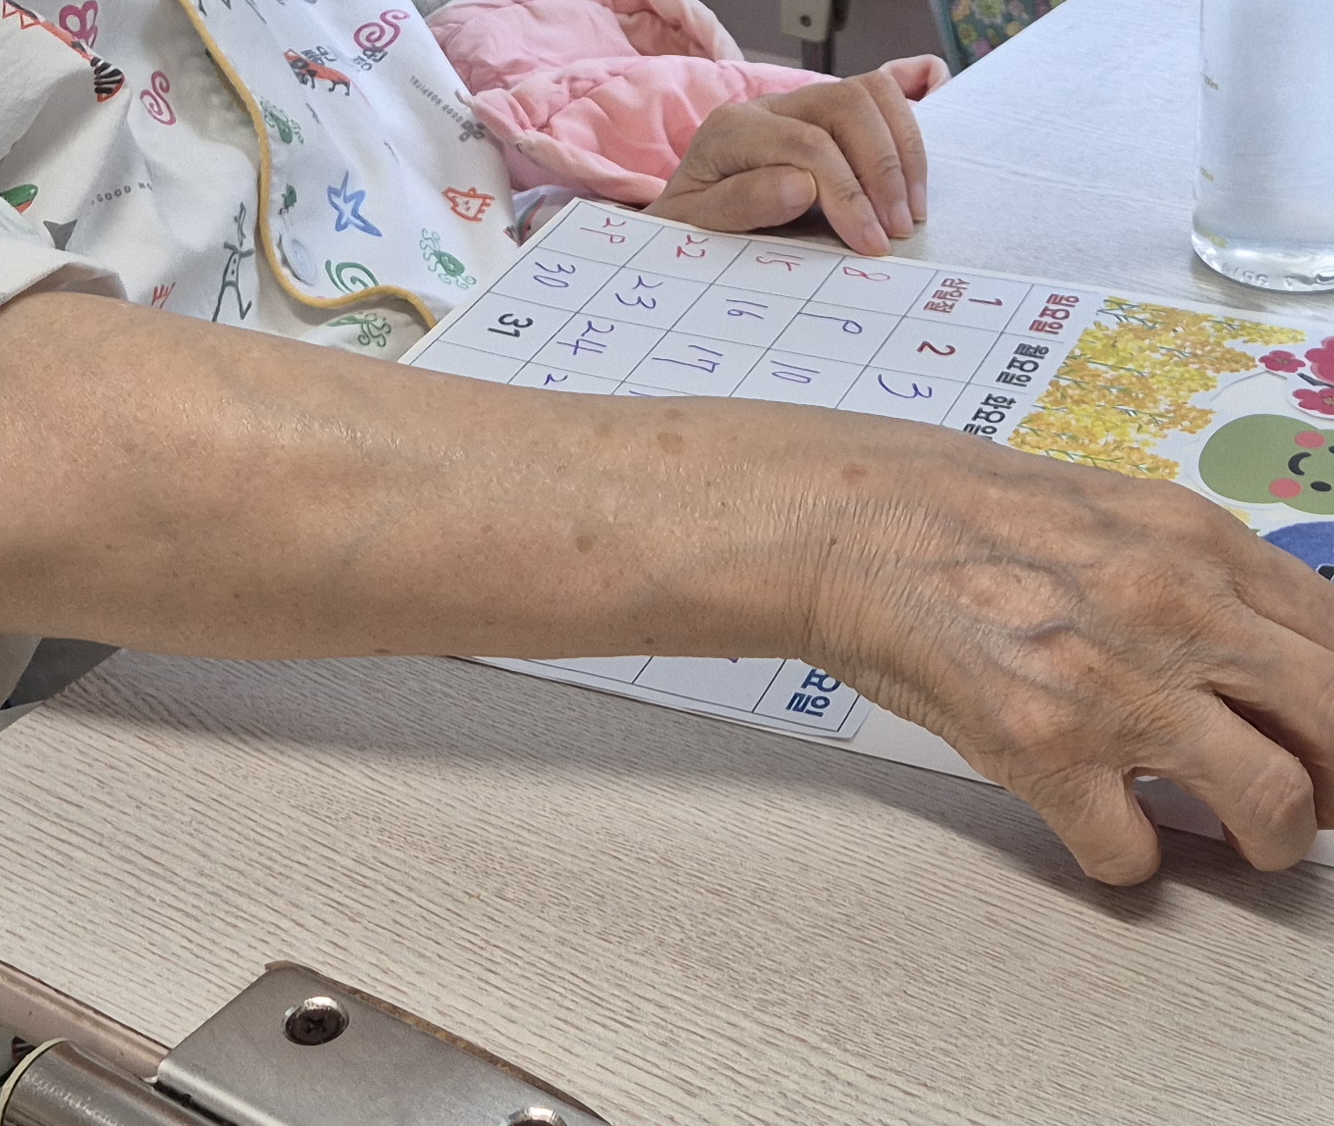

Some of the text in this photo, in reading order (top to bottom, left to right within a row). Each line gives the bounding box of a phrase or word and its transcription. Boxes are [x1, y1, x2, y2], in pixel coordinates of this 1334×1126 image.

[675, 234, 709, 259] 22
[756, 250, 805, 272] 15
[842, 265, 891, 282] 8
[531, 262, 576, 290] 30
[616, 275, 664, 312] 23
[923, 278, 971, 314] 삼일절
[969, 296, 1003, 308] 1
[725, 298, 769, 320] 16
[1028, 292, 1079, 336] 일요일
[487, 312, 533, 340] 31
[556, 320, 615, 356] 24
[651, 344, 724, 374] 17
[915, 340, 957, 358] 2
[769, 360, 821, 384] 10
[996, 343, 1049, 387] 월요일
[878, 374, 933, 404] 3
[786, 668, 843, 718] 요일
